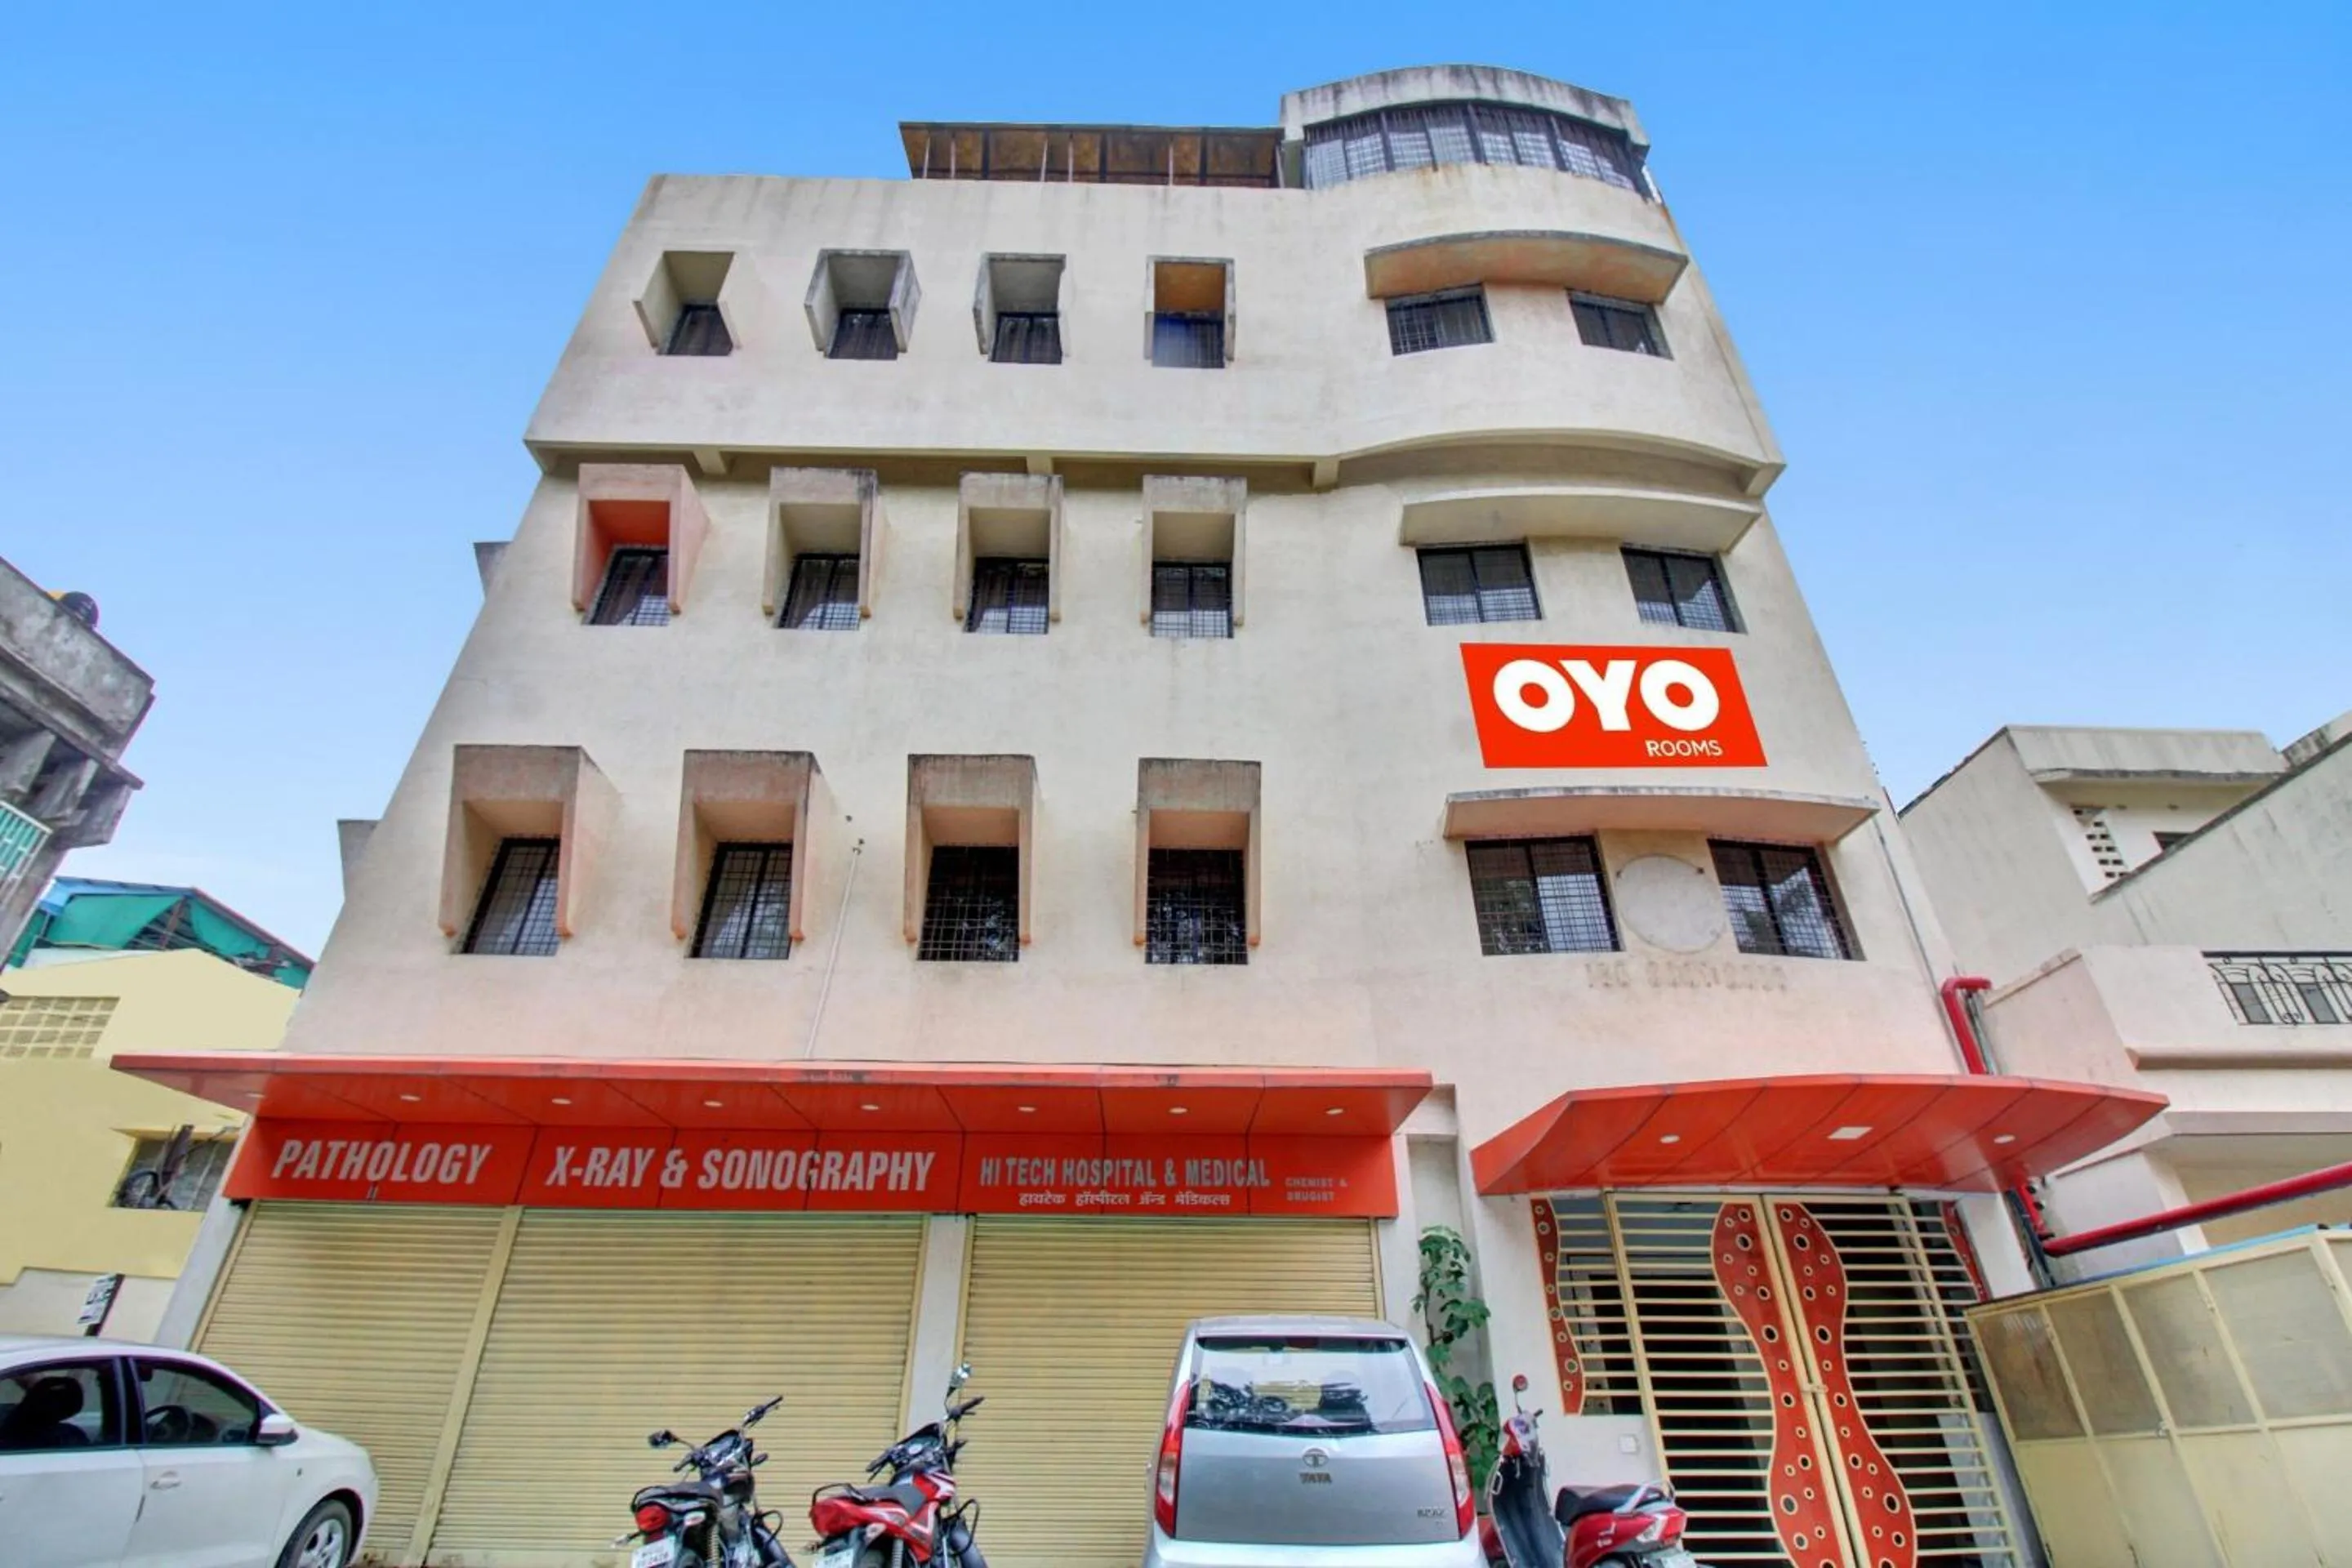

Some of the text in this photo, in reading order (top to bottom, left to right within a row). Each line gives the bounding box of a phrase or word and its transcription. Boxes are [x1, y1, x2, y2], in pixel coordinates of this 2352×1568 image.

[1493, 659, 1720, 733] OYO
[1646, 739, 1723, 757] ROOMS
[270, 1139, 492, 1185] PATHOLOGY
[546, 1147, 936, 1192] X-RAY & SONOGRAPHY
[980, 1157, 1271, 1187] HI TECH HOSPITAL & MEDICAL
[1299, 1472, 1332, 1484] TATA
